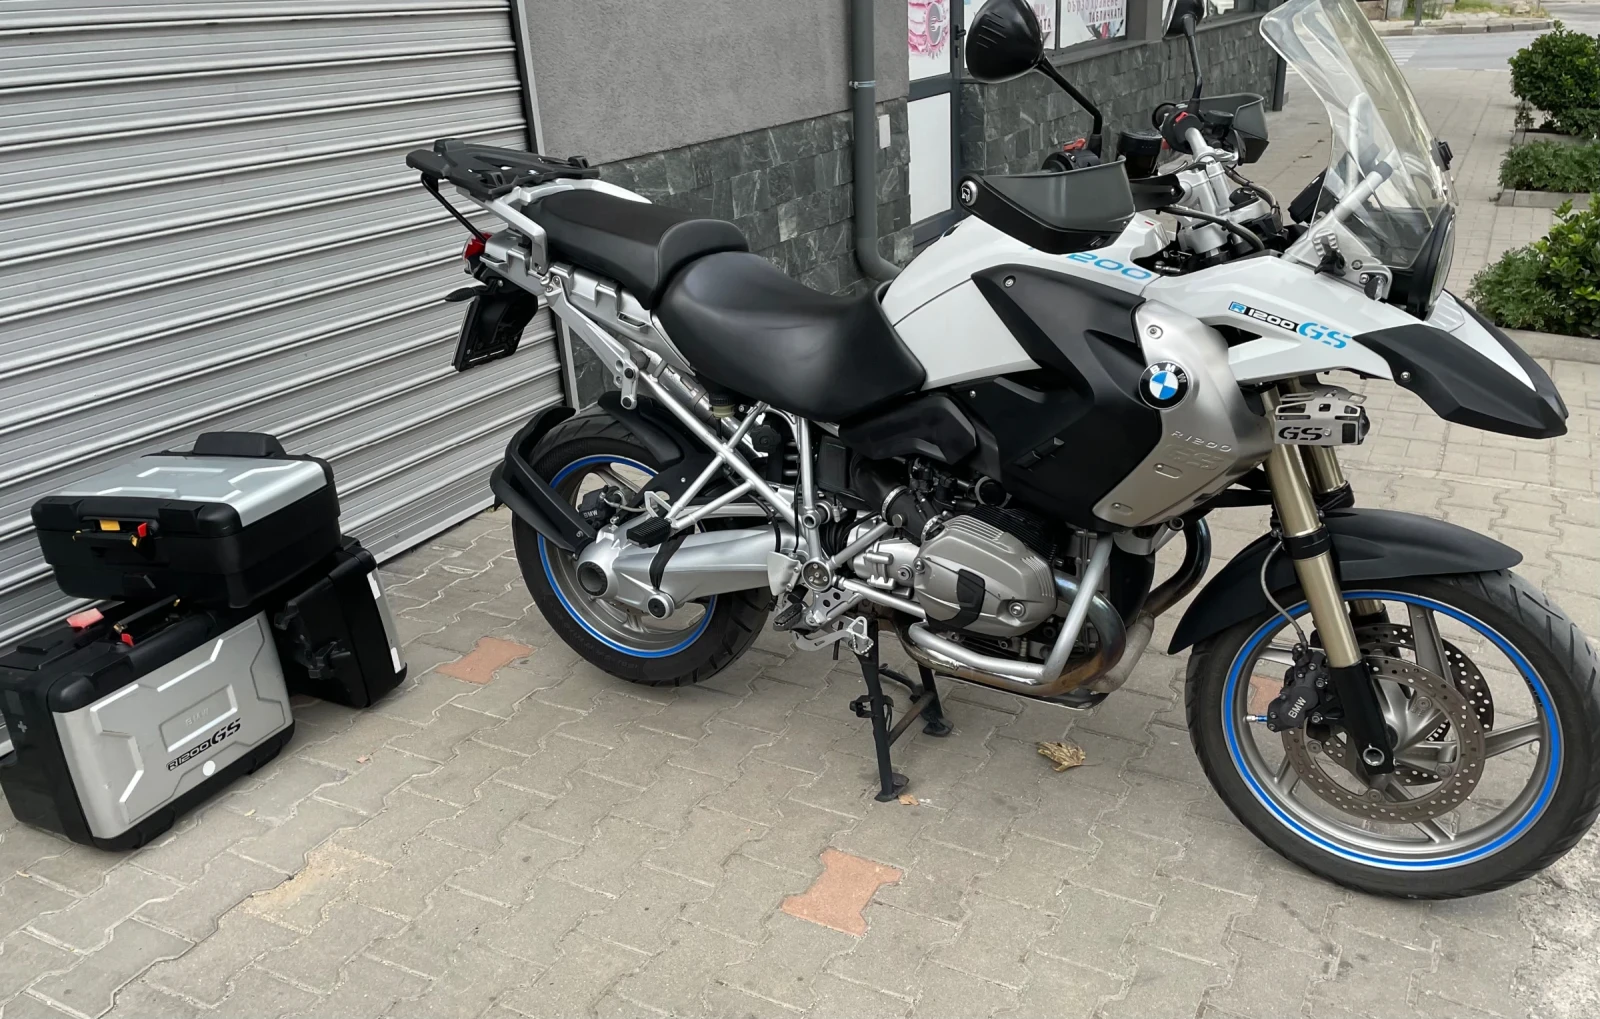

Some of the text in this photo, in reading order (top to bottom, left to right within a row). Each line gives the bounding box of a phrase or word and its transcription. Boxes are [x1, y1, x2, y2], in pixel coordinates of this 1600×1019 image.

[1066, 253, 1151, 280] 200
[1149, 363, 1187, 383] BMW
[1278, 426, 1323, 441] GS
[583, 509, 598, 519] BMW
[1287, 696, 1307, 719] BMW
